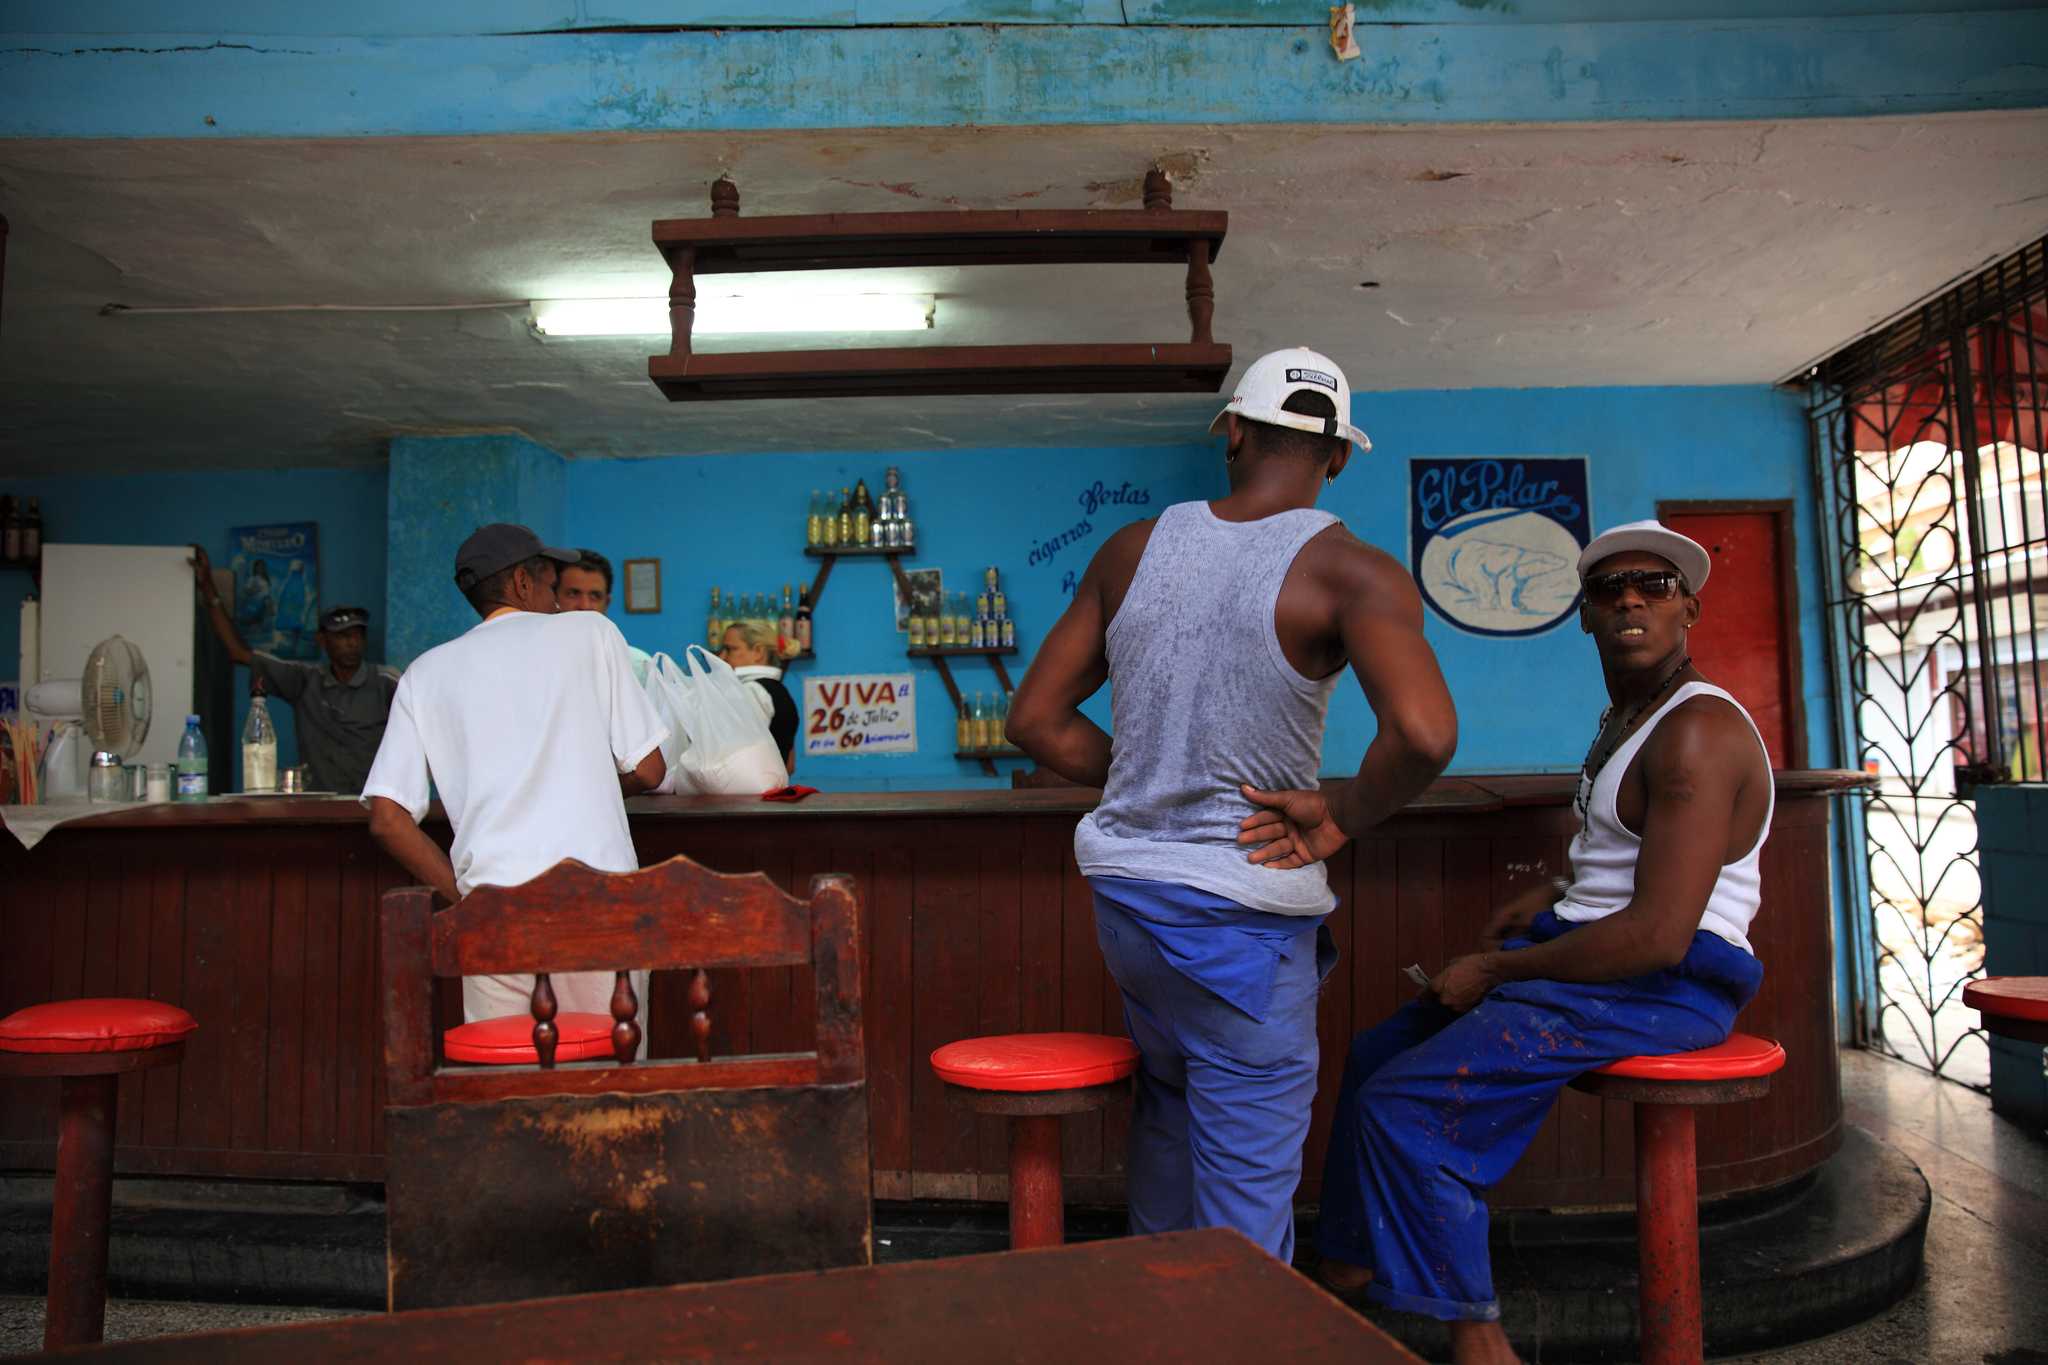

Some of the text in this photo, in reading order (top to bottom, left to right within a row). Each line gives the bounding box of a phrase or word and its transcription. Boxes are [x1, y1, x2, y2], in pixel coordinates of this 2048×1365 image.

[1418, 460, 1559, 530] El Polar
[1028, 518, 1093, 567] cigarros
[818, 682, 896, 708] VIVA
[810, 707, 845, 734] 26
[861, 707, 900, 726] Julio
[840, 728, 864, 748] 60
